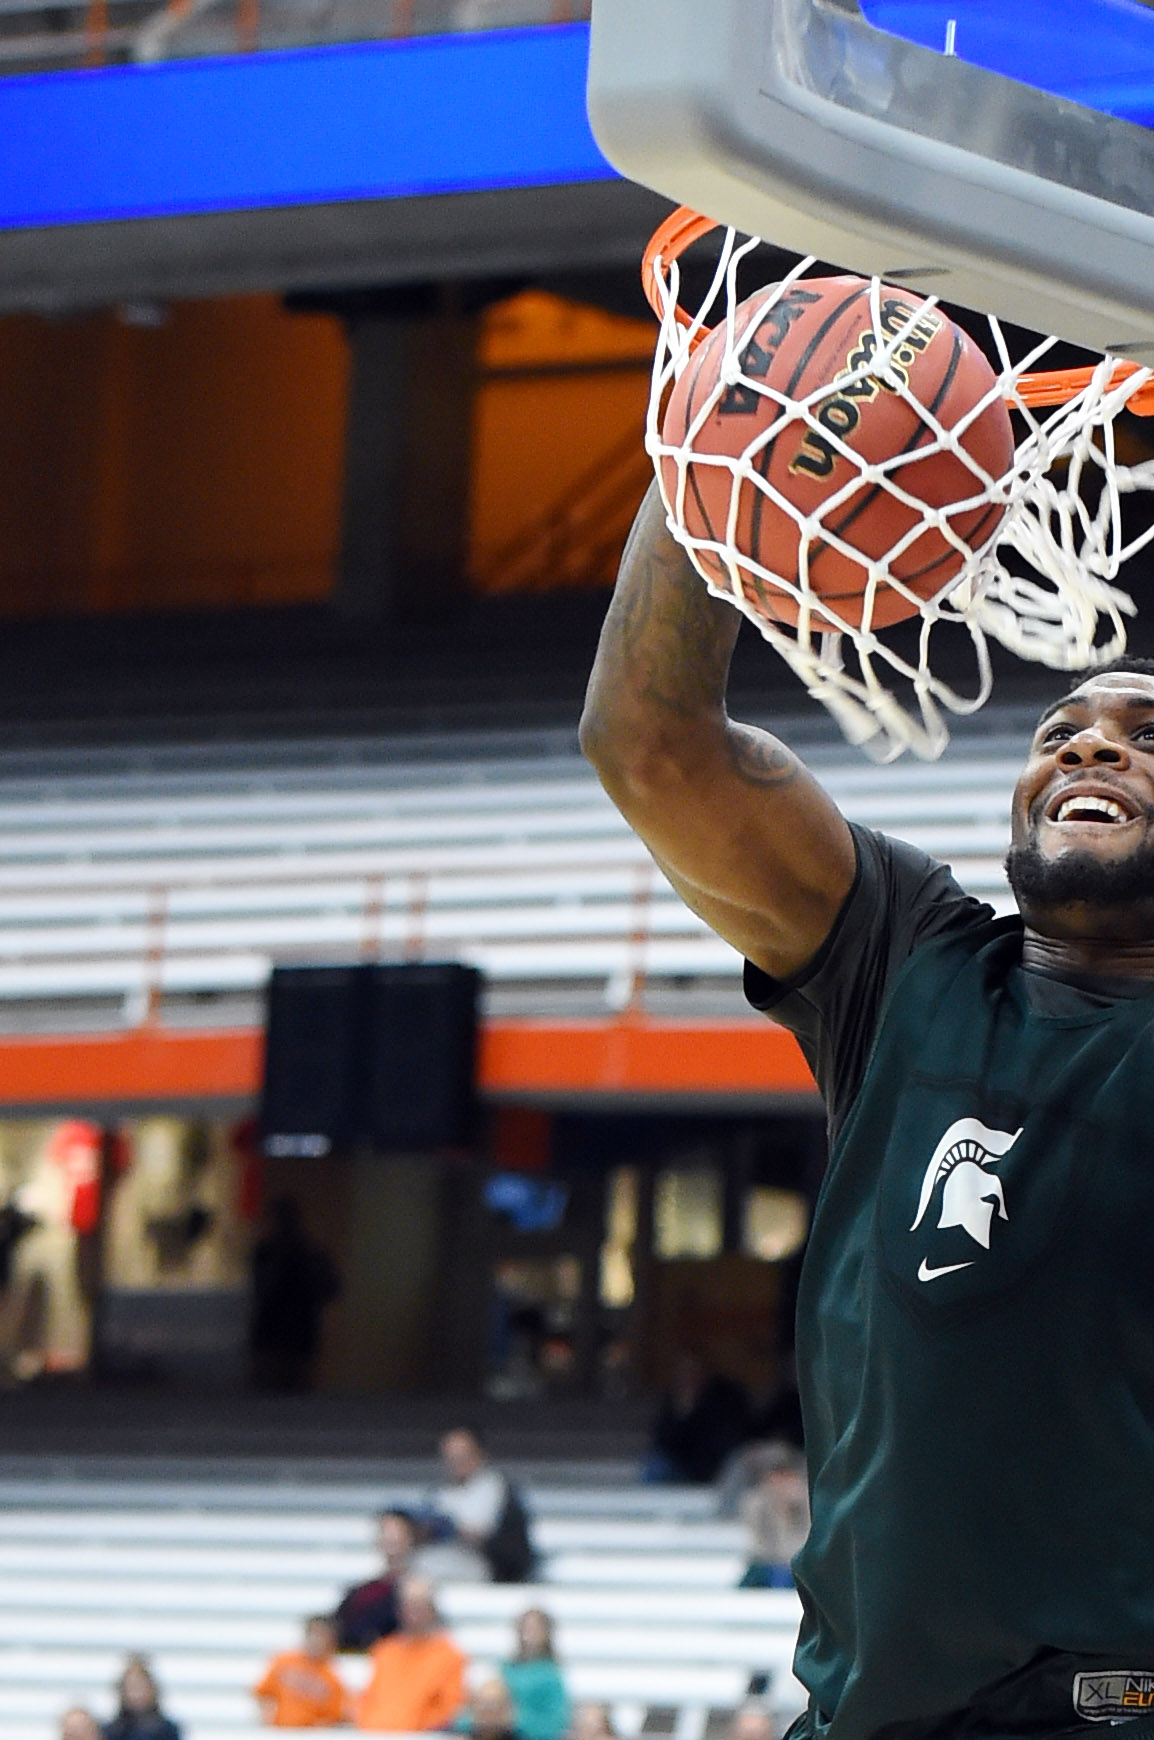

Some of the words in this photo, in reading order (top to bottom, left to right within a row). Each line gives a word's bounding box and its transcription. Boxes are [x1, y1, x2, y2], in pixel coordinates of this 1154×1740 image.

[718, 288, 824, 415] NCAA
[787, 297, 944, 484] Wilson
[1085, 1680, 1121, 1702] XL
